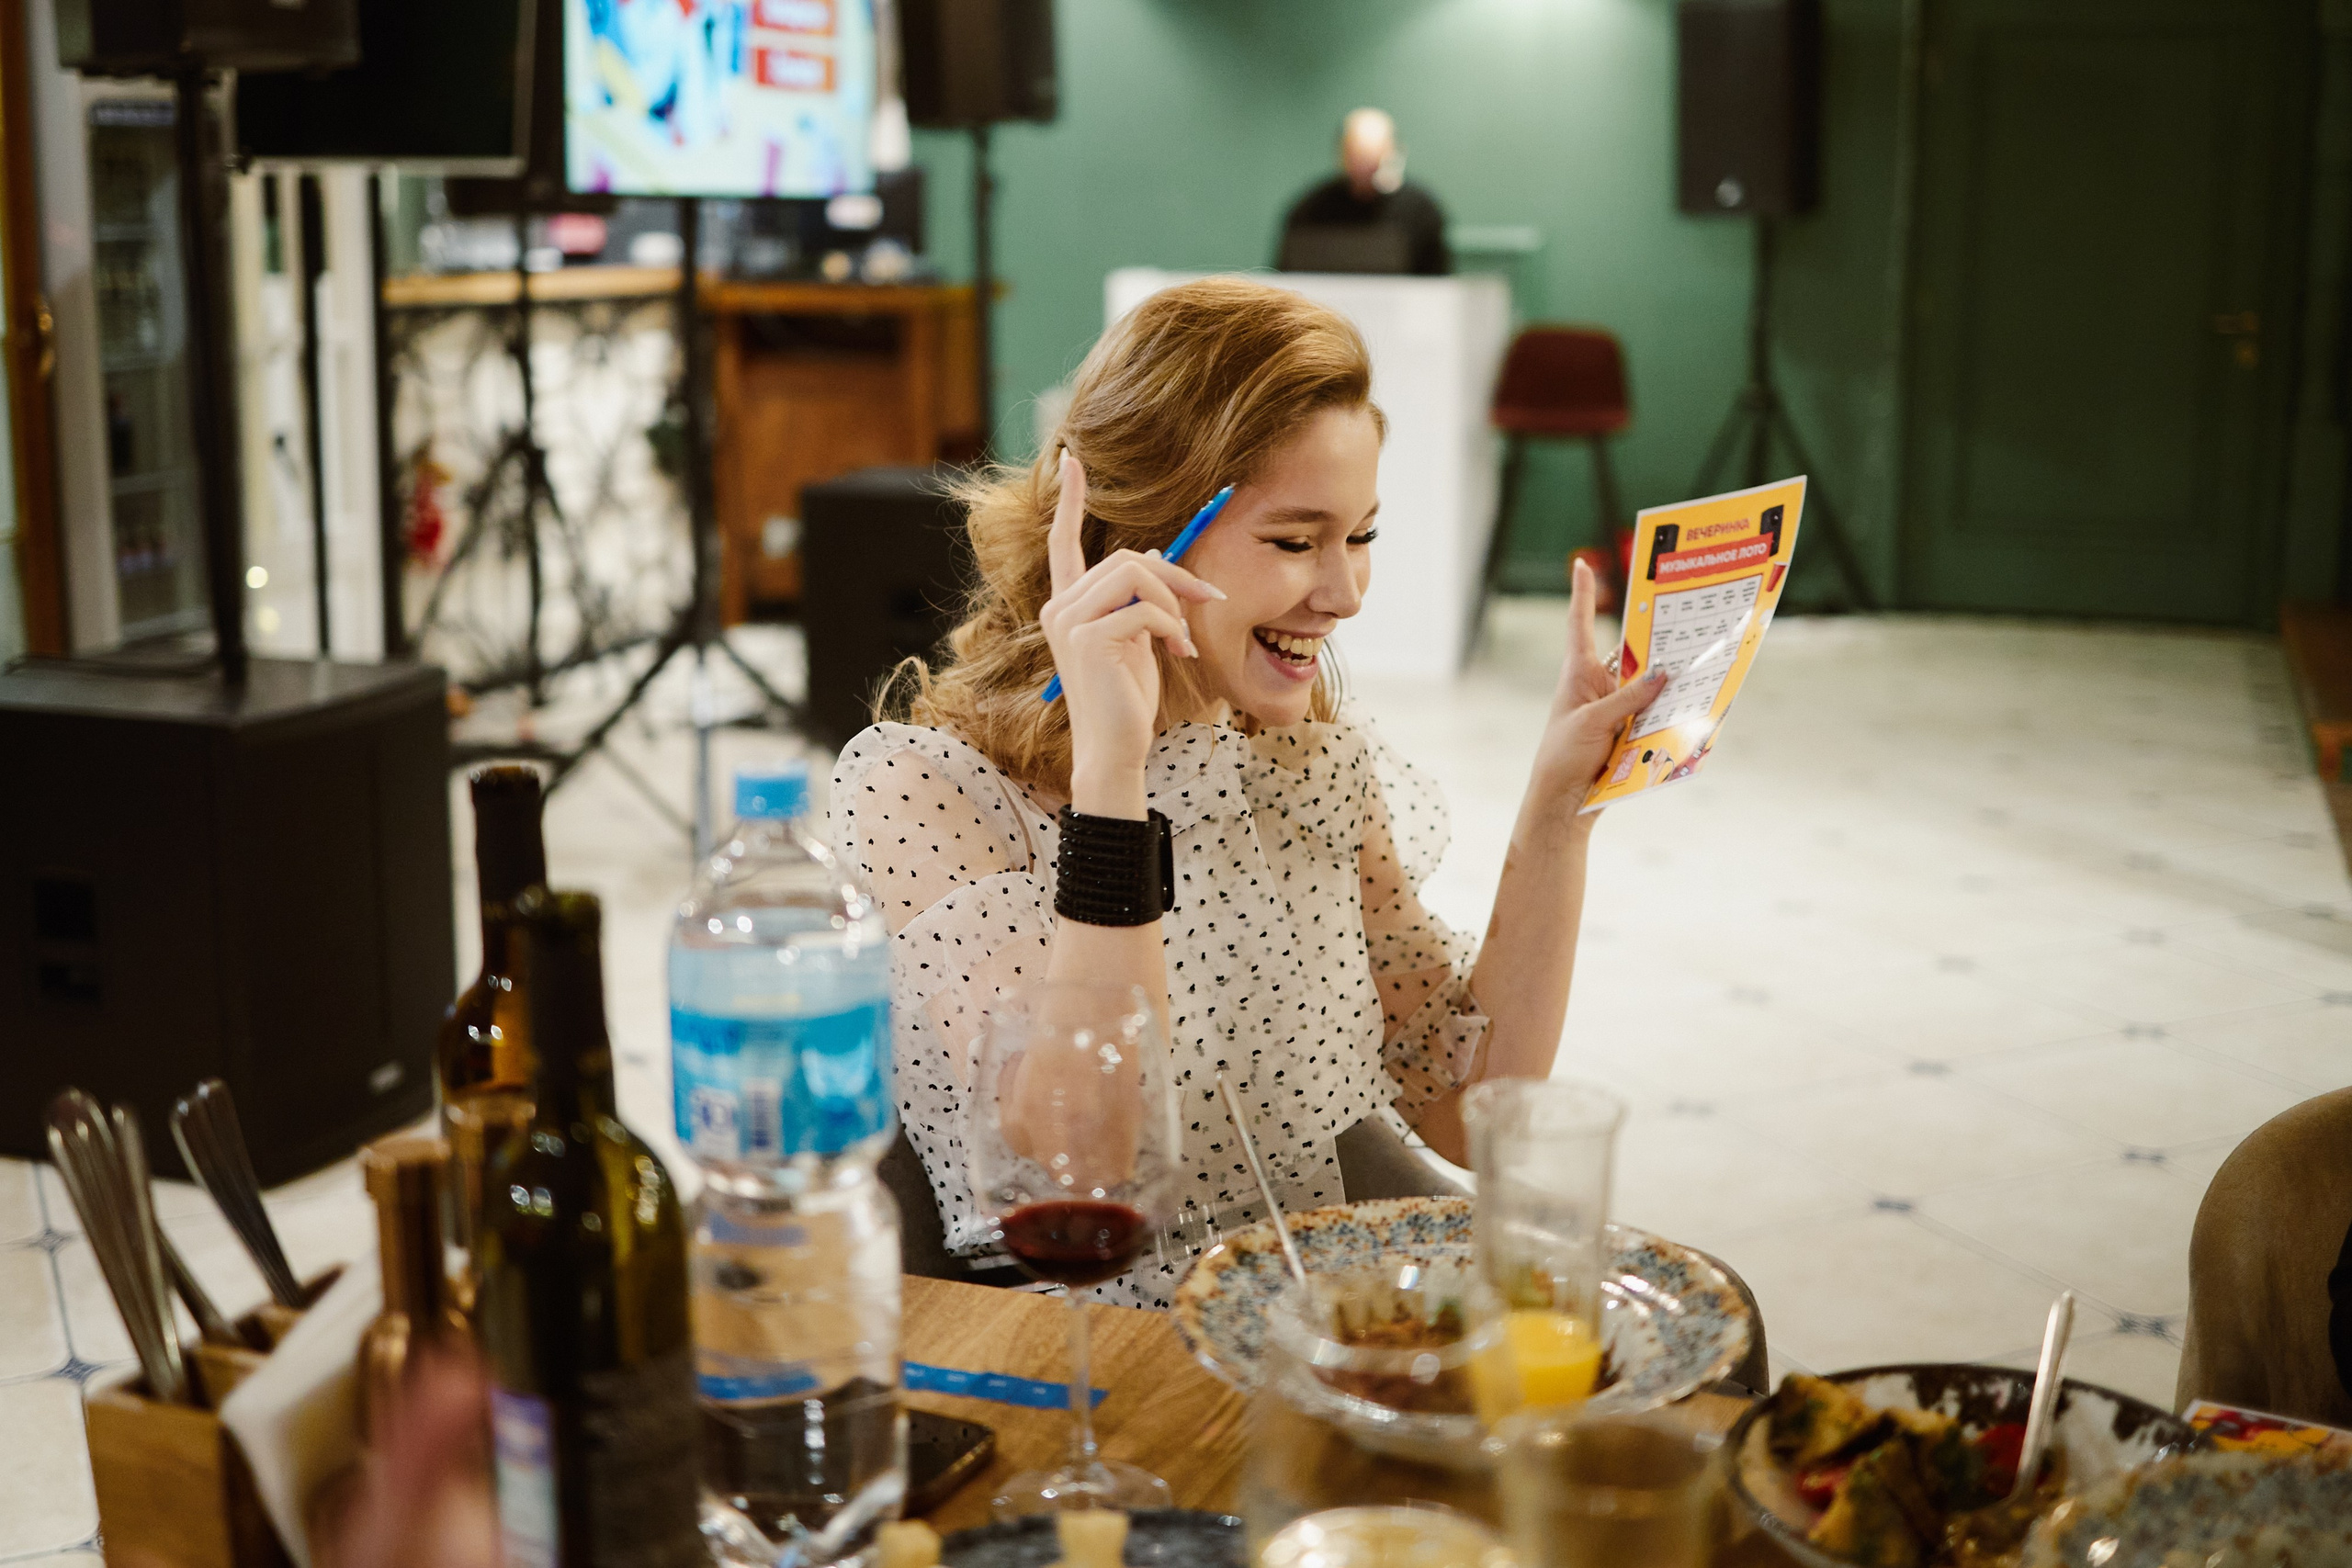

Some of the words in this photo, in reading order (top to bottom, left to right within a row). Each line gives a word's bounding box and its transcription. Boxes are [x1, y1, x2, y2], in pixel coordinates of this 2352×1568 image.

[1686, 518, 1749, 541] ВЕЧЕРИНКА
[1659, 548, 1737, 574] МУЗЫКАЛЬНОЕ
[1738, 542, 1767, 558] ЛОТО
